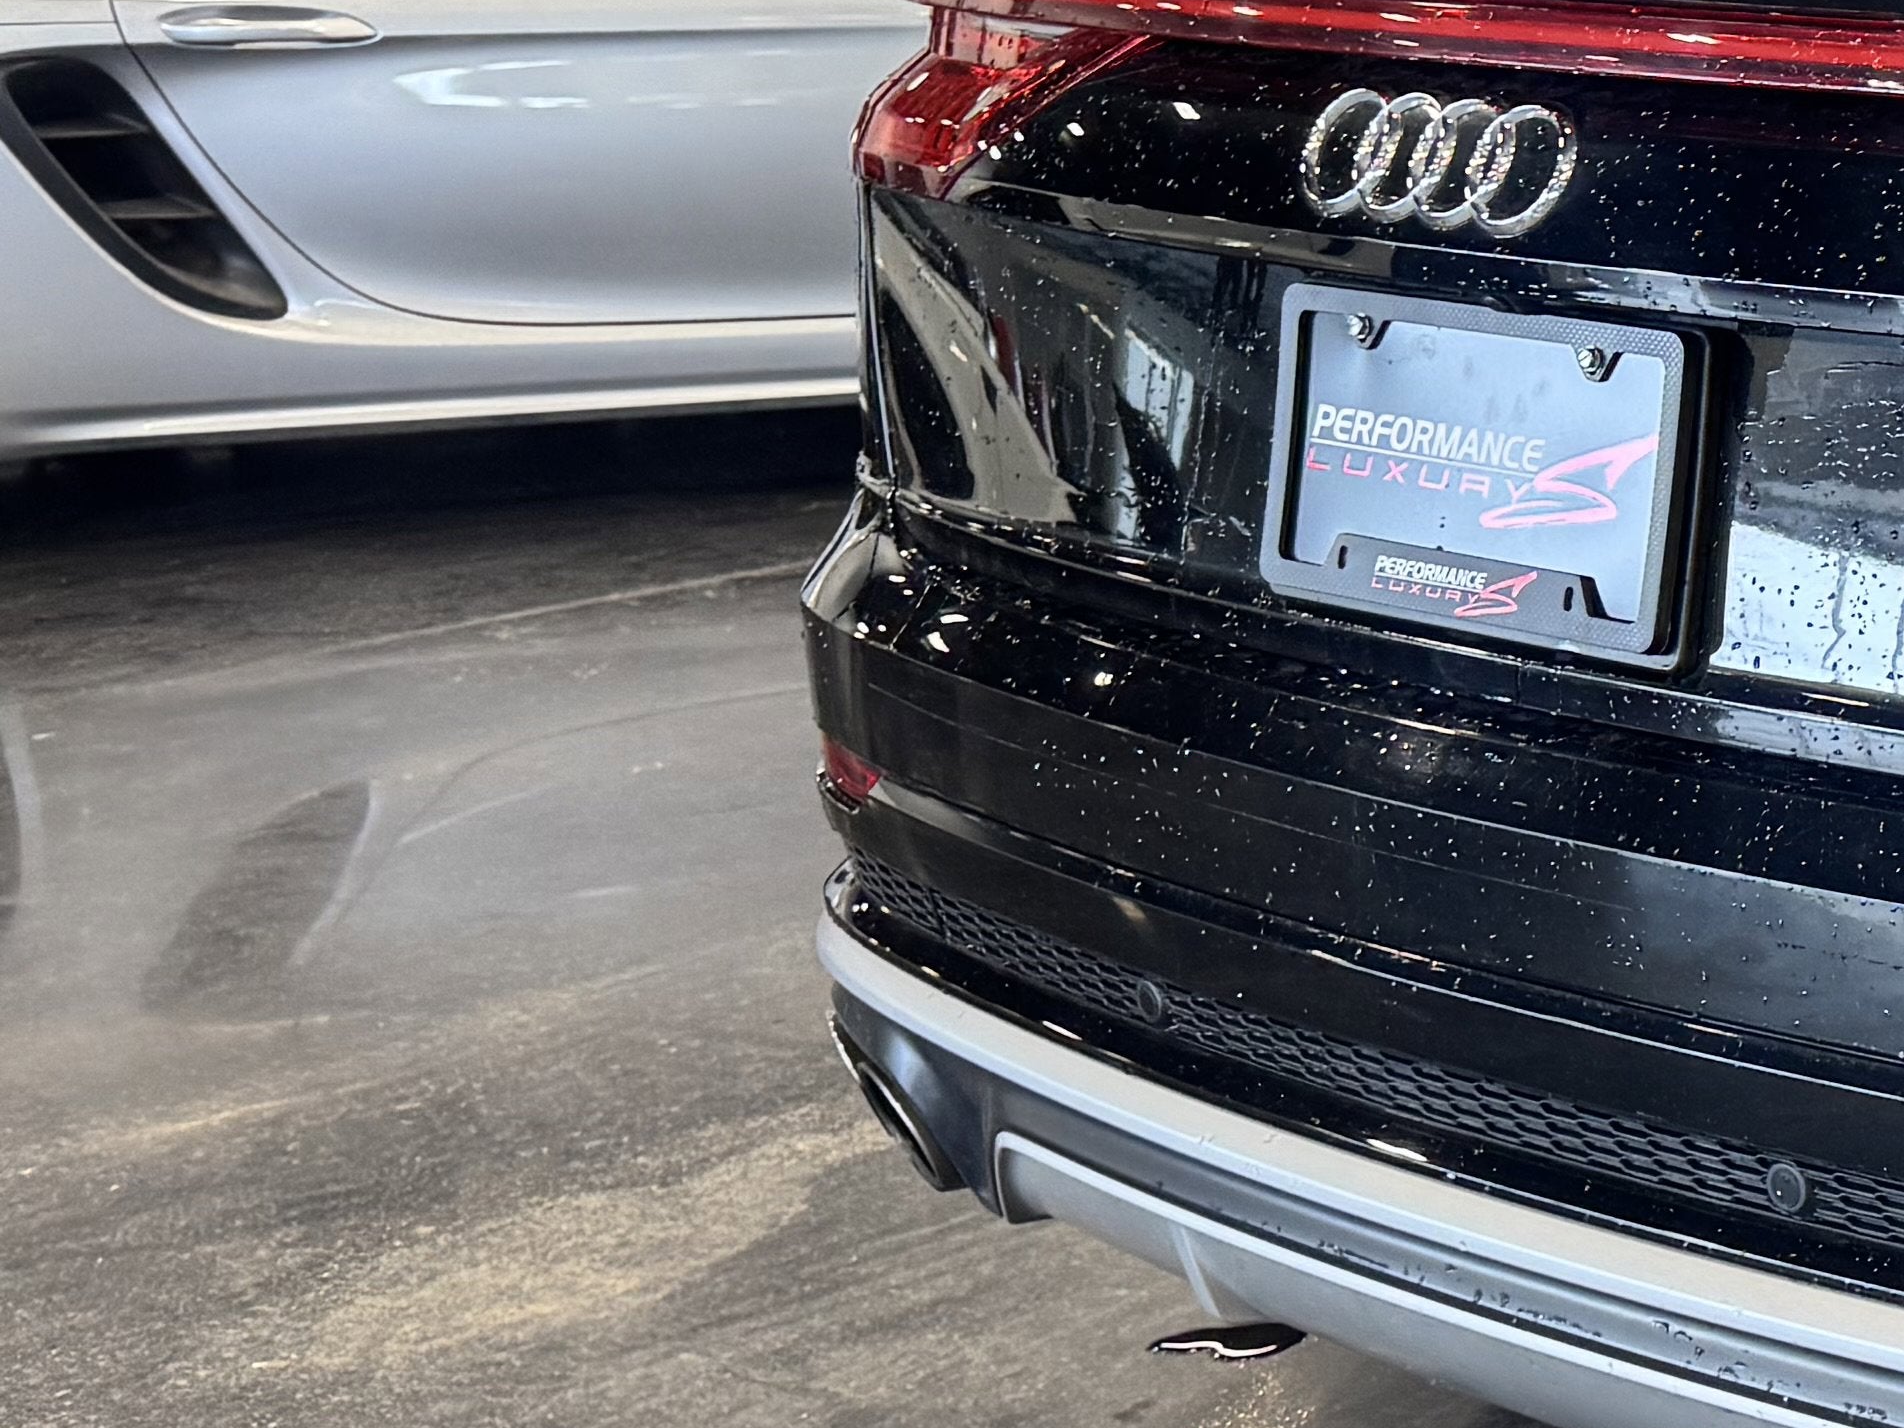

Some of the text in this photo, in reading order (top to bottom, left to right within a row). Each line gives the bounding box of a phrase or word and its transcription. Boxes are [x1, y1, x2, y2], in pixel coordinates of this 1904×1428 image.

[1311, 402, 1547, 472] PERFORMANCE
[1306, 445, 1535, 504] LUXURY
[1371, 576, 1481, 604] LUXURY
[1374, 554, 1489, 590] PERFORMANCE
